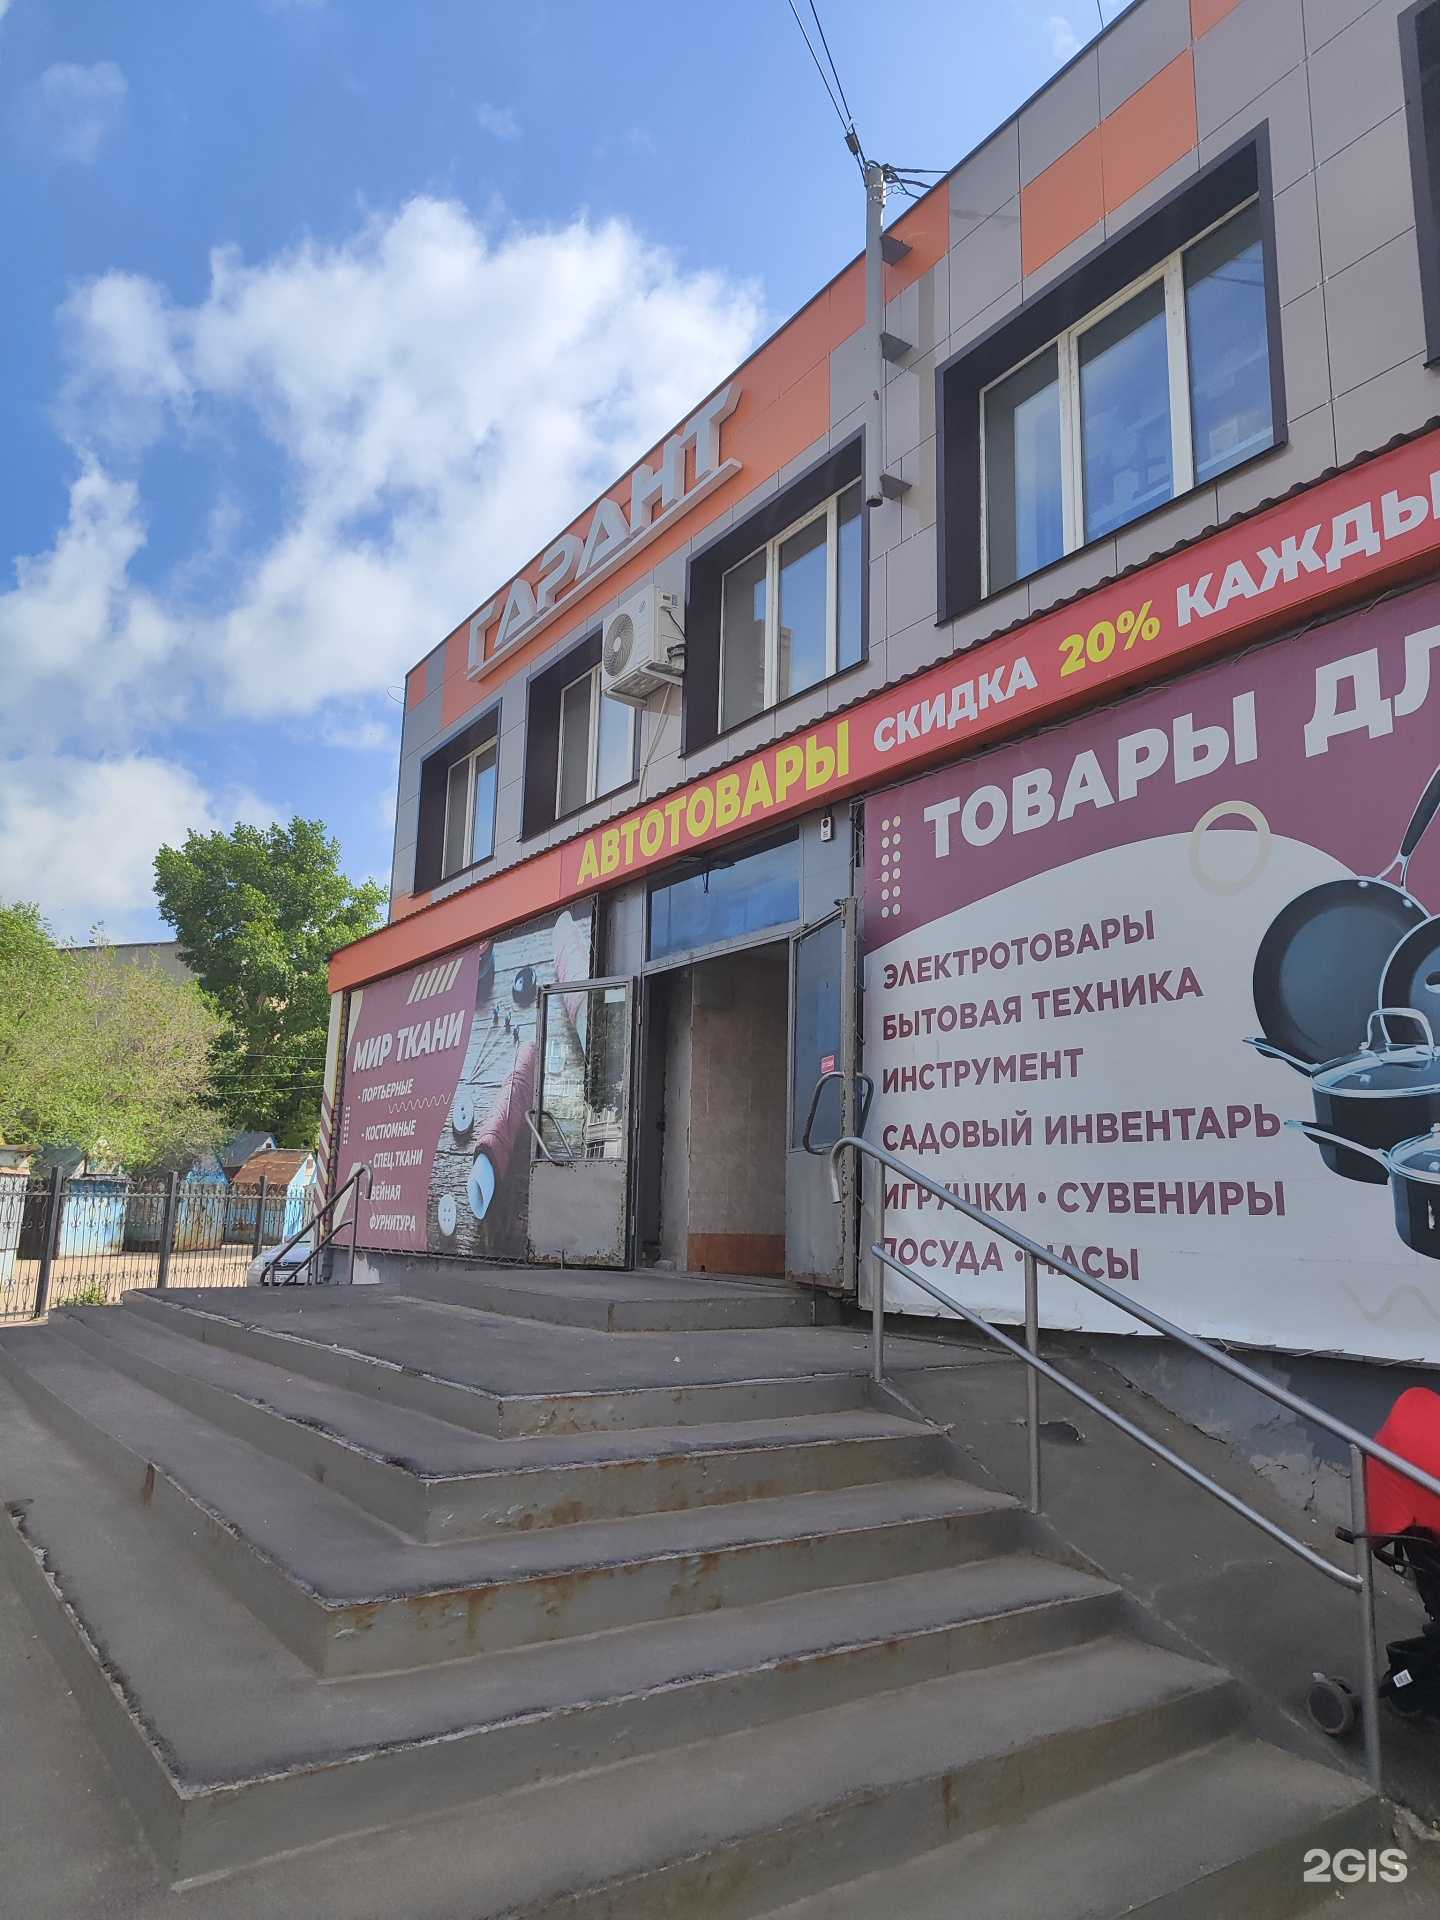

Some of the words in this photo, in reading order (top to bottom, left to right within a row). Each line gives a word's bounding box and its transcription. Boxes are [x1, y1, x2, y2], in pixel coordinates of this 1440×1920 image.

[468, 381, 743, 677] ГАРАНТ
[576, 720, 850, 886] АВТОТОВАРЫ
[872, 656, 1039, 753] СКИДКА
[1058, 600, 1161, 678] 20%
[1177, 471, 1440, 627] КАЖДЫ
[923, 690, 1258, 859] ТОВАРЫ
[882, 910, 1156, 990] ЭЛЕКТРОТОВАРЫ
[882, 994, 1022, 1041] БЫТОВАЯ
[1031, 967, 1204, 1018] ТЕХНИКА
[353, 1032, 393, 1073] МИР
[397, 1009, 466, 1062] ТКАНИ
[361, 1078, 414, 1103] ПОРТЬЕРНЫЕ
[882, 1048, 1084, 1095] ИНСТРУМЕНТ
[365, 1119, 416, 1142] КОСТЮМНЫЕ
[882, 1110, 1033, 1154] САДОВЫЙ
[1045, 1103, 1282, 1144] ИНВЕНТАРЬ
[369, 1212, 416, 1232] ФУРНИТУРА
[1057, 1181, 1286, 1216] СУВЕНИРЫ
